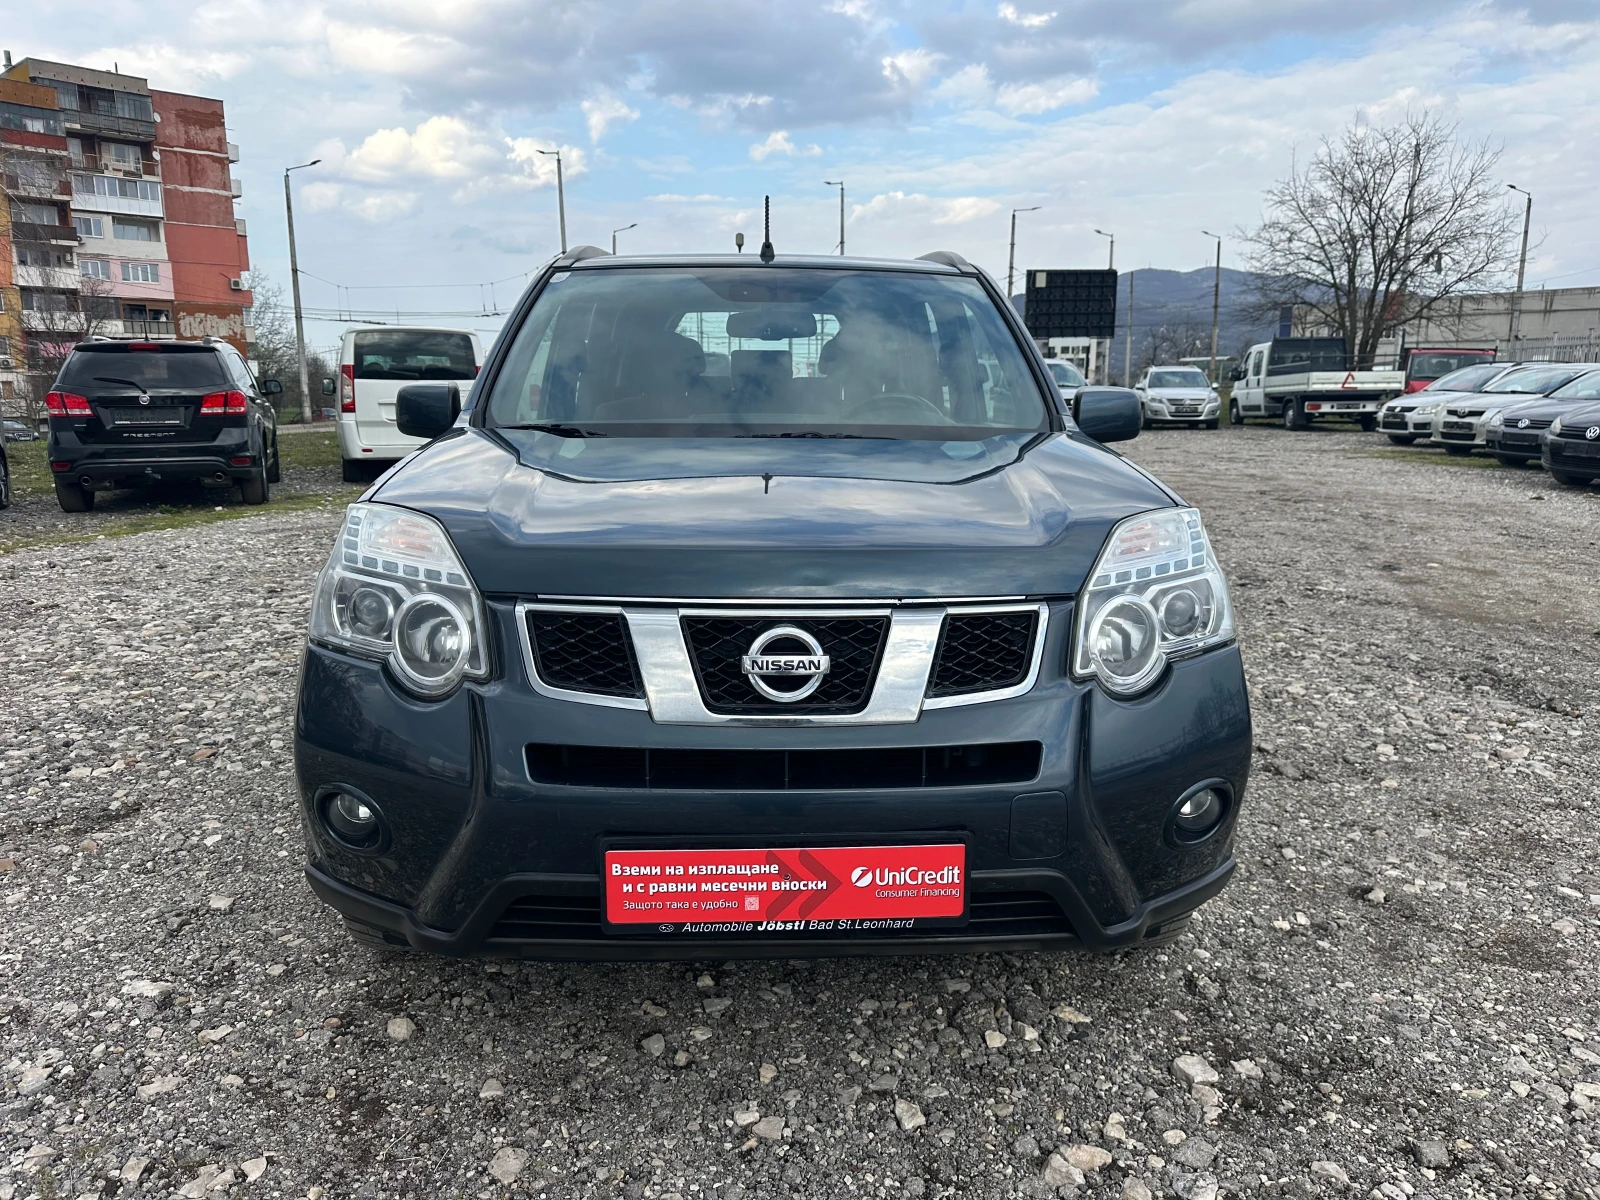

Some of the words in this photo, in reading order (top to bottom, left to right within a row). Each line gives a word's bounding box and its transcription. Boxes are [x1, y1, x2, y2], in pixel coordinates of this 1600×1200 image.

[751, 660, 820, 670] NISSAN
[611, 863, 661, 876] Вземи
[665, 864, 684, 876] на
[688, 862, 779, 876] изплащане
[875, 866, 961, 886] UniCredit
[622, 882, 633, 893] и
[636, 882, 645, 893] с
[648, 881, 697, 896] равни
[701, 880, 767, 893] месечни
[771, 879, 827, 891] вноски
[875, 888, 918, 898] Consumer
[920, 887, 960, 898] Financing
[623, 899, 663, 911] Защото
[665, 900, 690, 909] така
[692, 901, 698, 909] е
[701, 899, 739, 910] удобно
[682, 922, 753, 932] Automobile
[757, 920, 805, 931] Jöbstl
[809, 919, 833, 930] Bad
[838, 918, 914, 930] St.Leonhard
